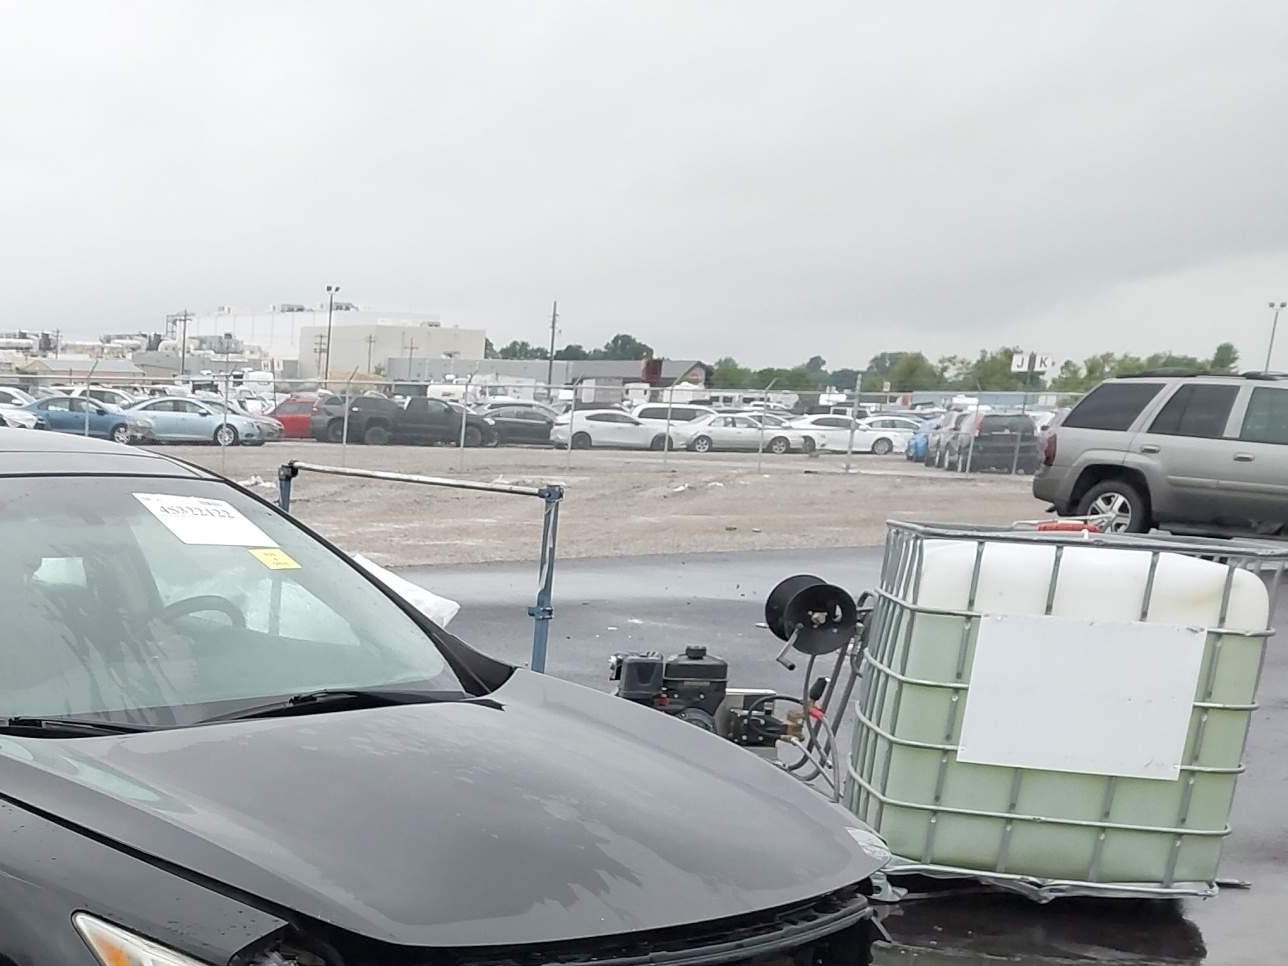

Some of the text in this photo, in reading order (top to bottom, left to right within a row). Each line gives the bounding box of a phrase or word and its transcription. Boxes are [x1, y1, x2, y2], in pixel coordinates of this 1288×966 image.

[1015, 355, 1025, 369] J
[1038, 355, 1049, 369] K
[159, 504, 236, 520] 45322122
